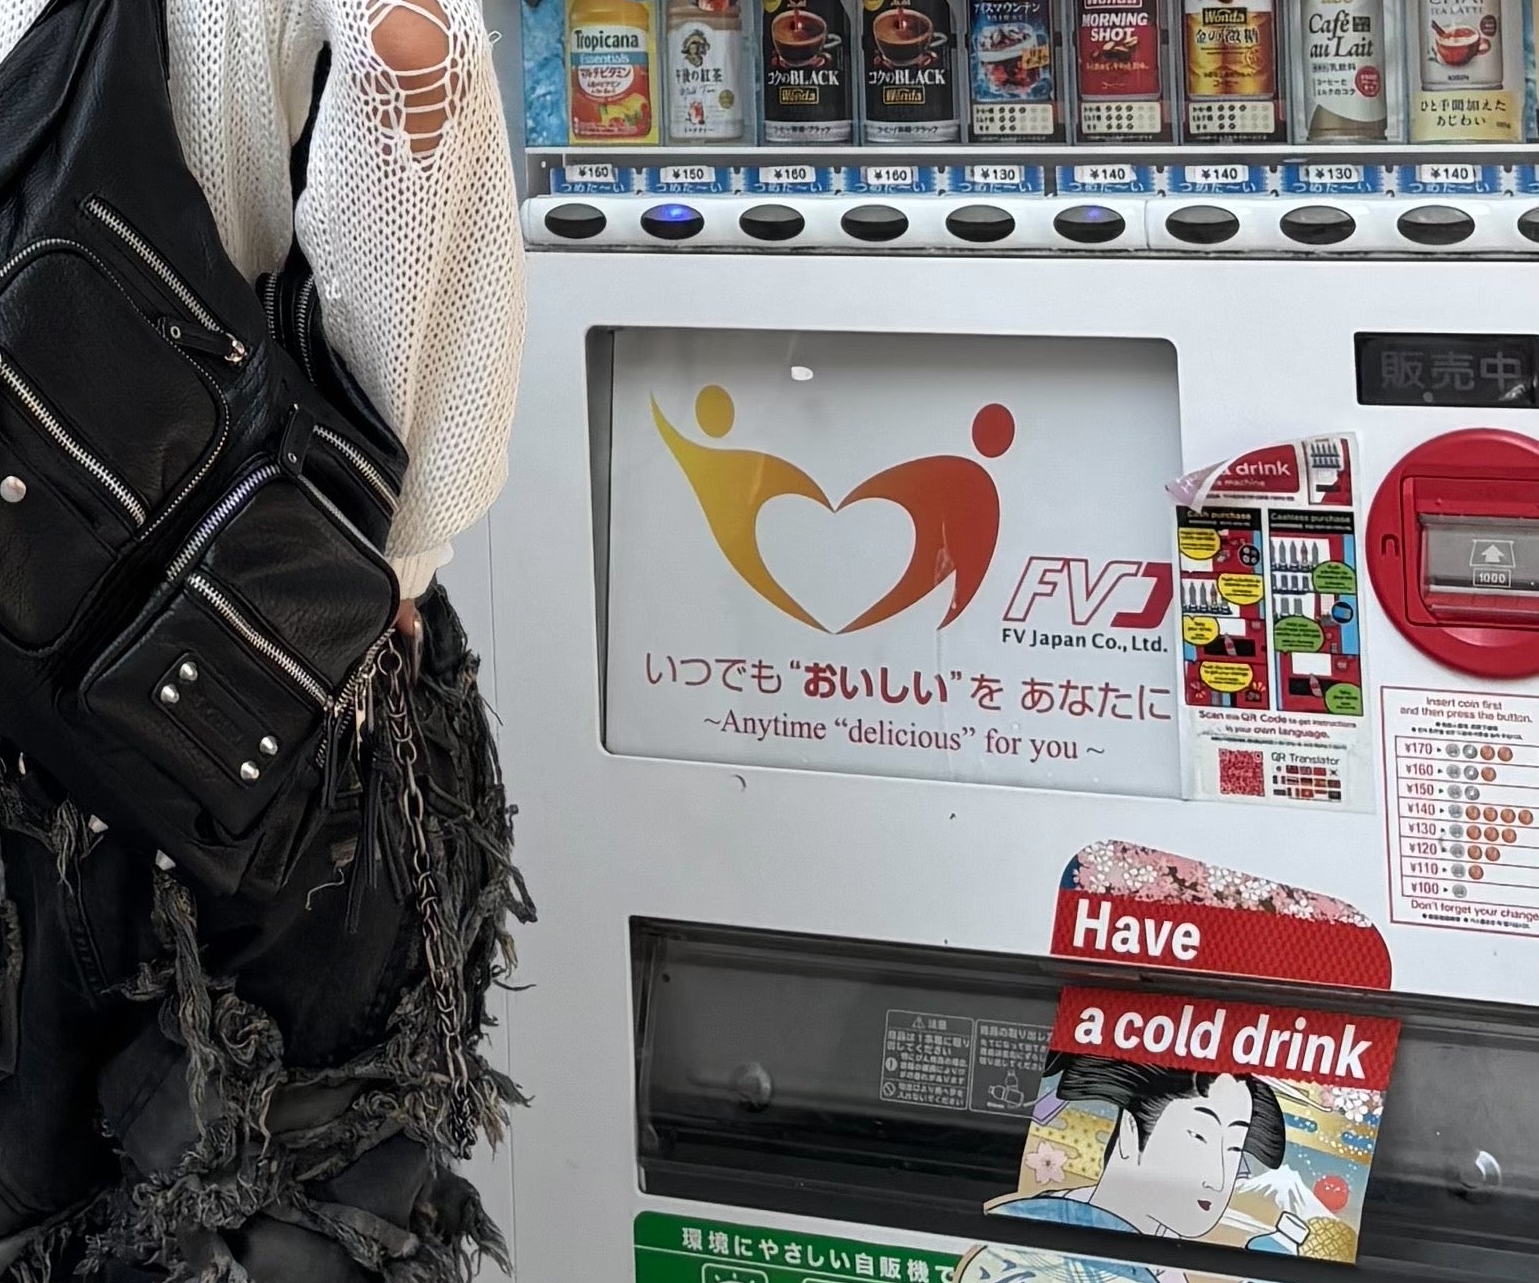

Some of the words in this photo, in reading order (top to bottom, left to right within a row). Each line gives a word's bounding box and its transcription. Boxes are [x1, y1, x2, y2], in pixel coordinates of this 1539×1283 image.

[1082, 13, 1148, 27] MORNING
[1205, 10, 1245, 23] Wonda
[1309, 10, 1349, 41] Café
[574, 30, 639, 51] Tropicana
[1090, 28, 1135, 43] SHOT
[1310, 45, 1329, 58] au
[1333, 37, 1373, 58] Lait
[580, 53, 630, 64] Essentials
[676, 68, 723, 84] 午後の紅茶
[1421, 99, 1506, 112] ひと手間加えた
[1437, 116, 1486, 127] あじわい
[1381, 351, 1522, 391] 販売中
[1236, 461, 1291, 476] drink
[1479, 572, 1506, 584] 1000
[1002, 629, 1026, 644] FV
[1029, 629, 1086, 650] Japan
[1091, 633, 1127, 652] Co.,
[1132, 635, 1168, 653] Ltd.
[1019, 679, 1172, 721] あなたに
[1426, 697, 1455, 708] Insert
[1458, 699, 1480, 709] coin
[1482, 701, 1502, 711] first
[1198, 710, 1224, 719] Scan
[1240, 712, 1257, 722] QR
[1260, 713, 1287, 723] Code
[1400, 707, 1419, 716] and
[1421, 707, 1444, 717] then
[1447, 710, 1476, 719] press
[984, 724, 1023, 756] for
[1029, 737, 1078, 763] you
[1405, 742, 1433, 755] ¥170
[1271, 751, 1286, 762] QR
[1289, 753, 1341, 765] Translator
[1406, 764, 1434, 776] ¥160
[1406, 784, 1434, 796] ¥150
[1408, 803, 1436, 816] ¥140
[1408, 822, 1436, 835] ¥130
[1409, 842, 1437, 855] ¥120
[1410, 862, 1438, 875] ¥110
[1411, 882, 1439, 895] ¥100
[1441, 903, 1471, 915] forget
[1474, 907, 1498, 917] your
[1071, 898, 1202, 961] Have
[1074, 1007, 1104, 1045] a
[1113, 1004, 1223, 1060] cold
[1232, 1016, 1373, 1080] drink
